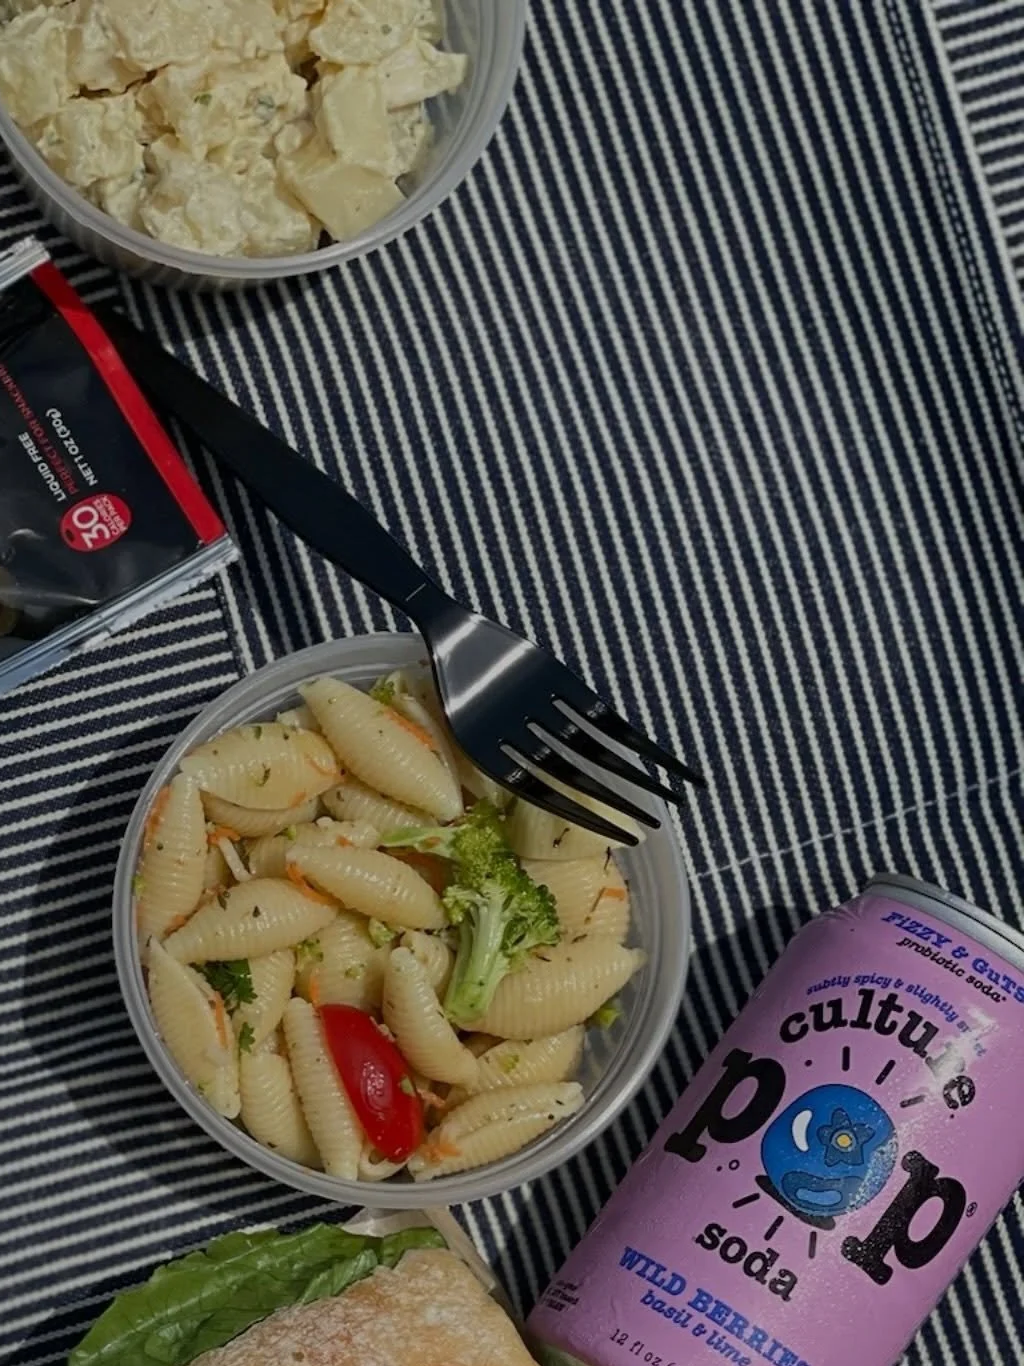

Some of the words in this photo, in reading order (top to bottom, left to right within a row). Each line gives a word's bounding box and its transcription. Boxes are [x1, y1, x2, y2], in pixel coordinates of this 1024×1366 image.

[17, 430, 43, 464] FREE
[26, 416, 50, 445] FOR
[62, 435, 79, 455] OZ
[40, 441, 81, 496] PERFECT
[72, 452, 84, 463] 1
[77, 459, 99, 486] NET
[35, 460, 67, 502] LIQUID
[92, 497, 121, 537] CALORIES
[99, 493, 117, 516] PACK
[111, 513, 127, 532] PER
[68, 500, 113, 549] 30
[895, 935, 964, 975] probiotic
[952, 944, 969, 961] &
[807, 974, 849, 994] subtly
[853, 976, 891, 988] spicy
[905, 984, 958, 1022] slightly
[618, 1245, 687, 1295] WILD
[694, 1219, 796, 1301] soda
[640, 1288, 694, 1329] basil
[690, 1321, 708, 1340] &
[608, 1326, 629, 1347] 12
